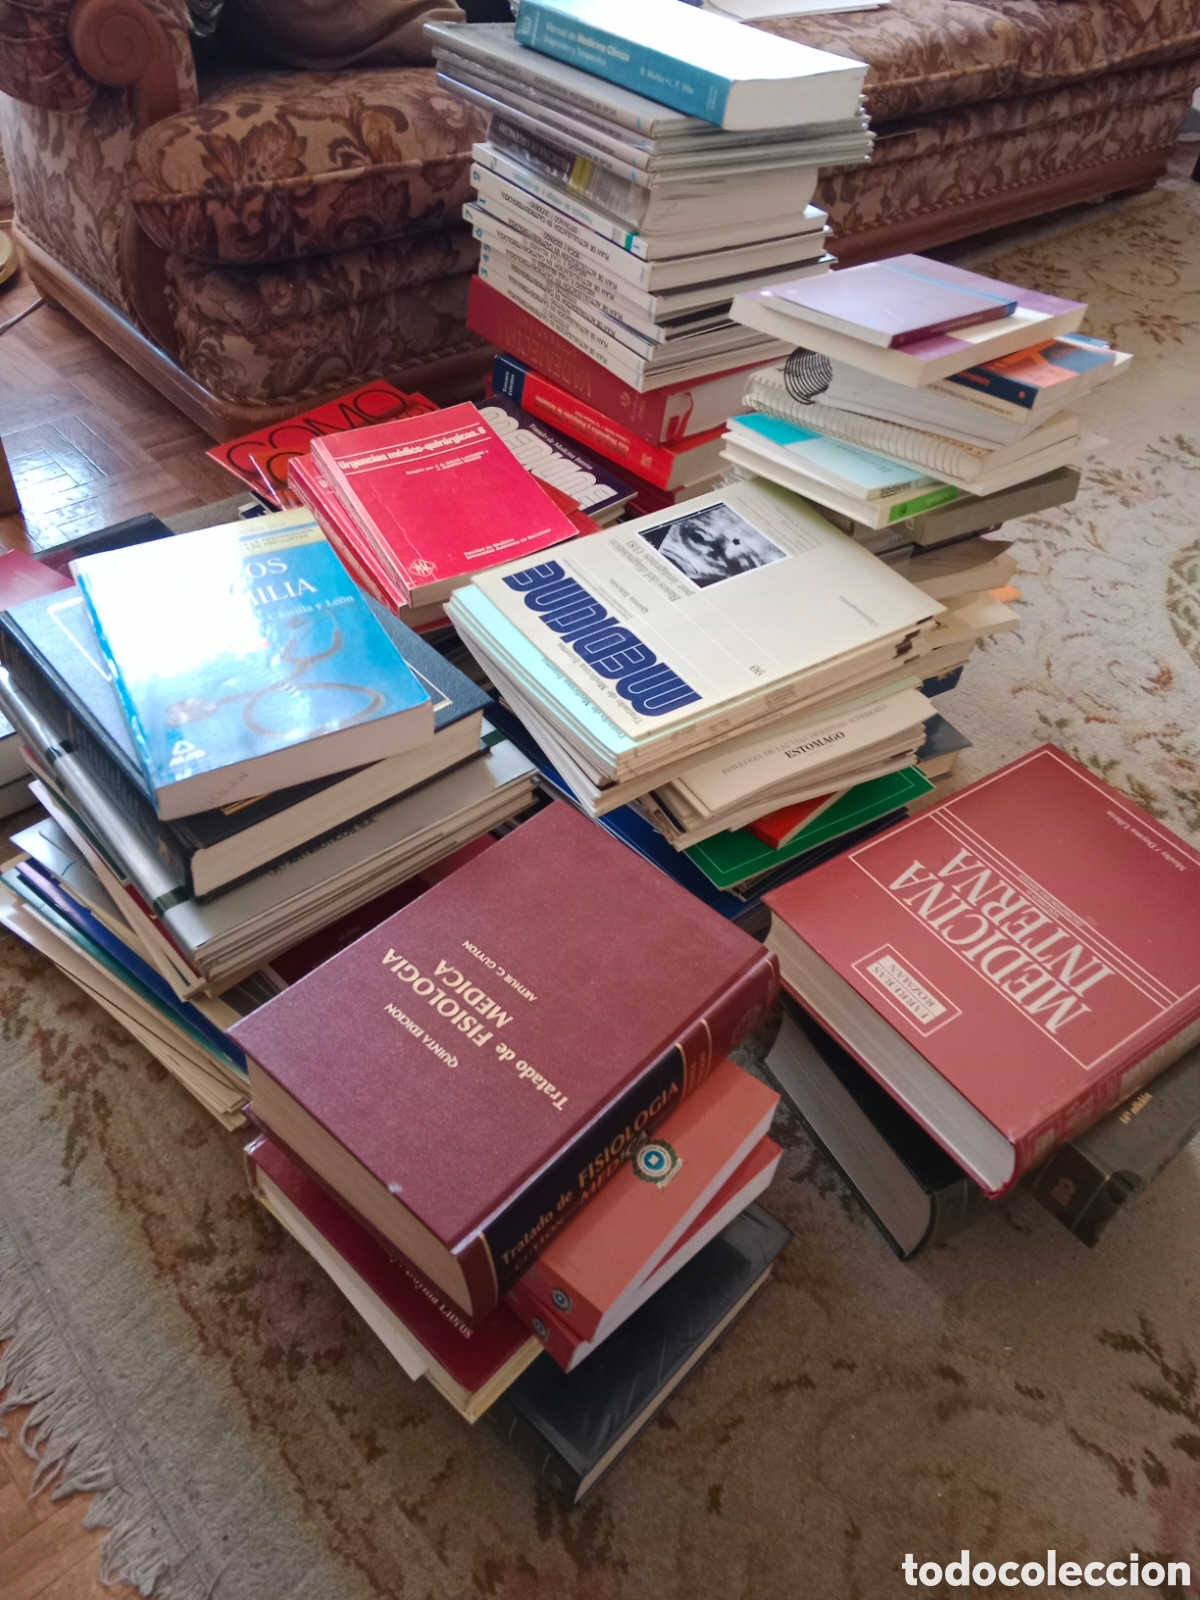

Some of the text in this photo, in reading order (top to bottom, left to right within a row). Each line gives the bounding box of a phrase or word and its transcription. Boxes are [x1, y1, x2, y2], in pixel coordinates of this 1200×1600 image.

[575, 33, 607, 52] Medicina
[595, 247, 611, 260] PLAN
[337, 450, 388, 474] Urgencias
[643, 568, 660, 585] del
[656, 579, 681, 604] Bases
[676, 580, 696, 599] por
[325, 594, 355, 607] León
[555, 640, 643, 725] Tratado de Medicina Interna
[562, 677, 591, 706] Medicina
[783, 729, 846, 760] ESTOMAGO
[888, 859, 1092, 1034] MEDICINA
[937, 848, 1116, 999] INTERNA
[461, 938, 538, 1003] ARTHUR C. GUYTON
[870, 963, 930, 1020] FARRERAS
[886, 961, 936, 1008] ROZMAN
[430, 957, 514, 1032] MEDICA
[379, 946, 570, 1111] Tratado de FISIOLOGIA
[382, 1000, 461, 1070] QUINTA EDICION
[498, 1208, 555, 1266] Tratado
[552, 1188, 575, 1211] de
[573, 1080, 680, 1190] FISIOLOGIA
